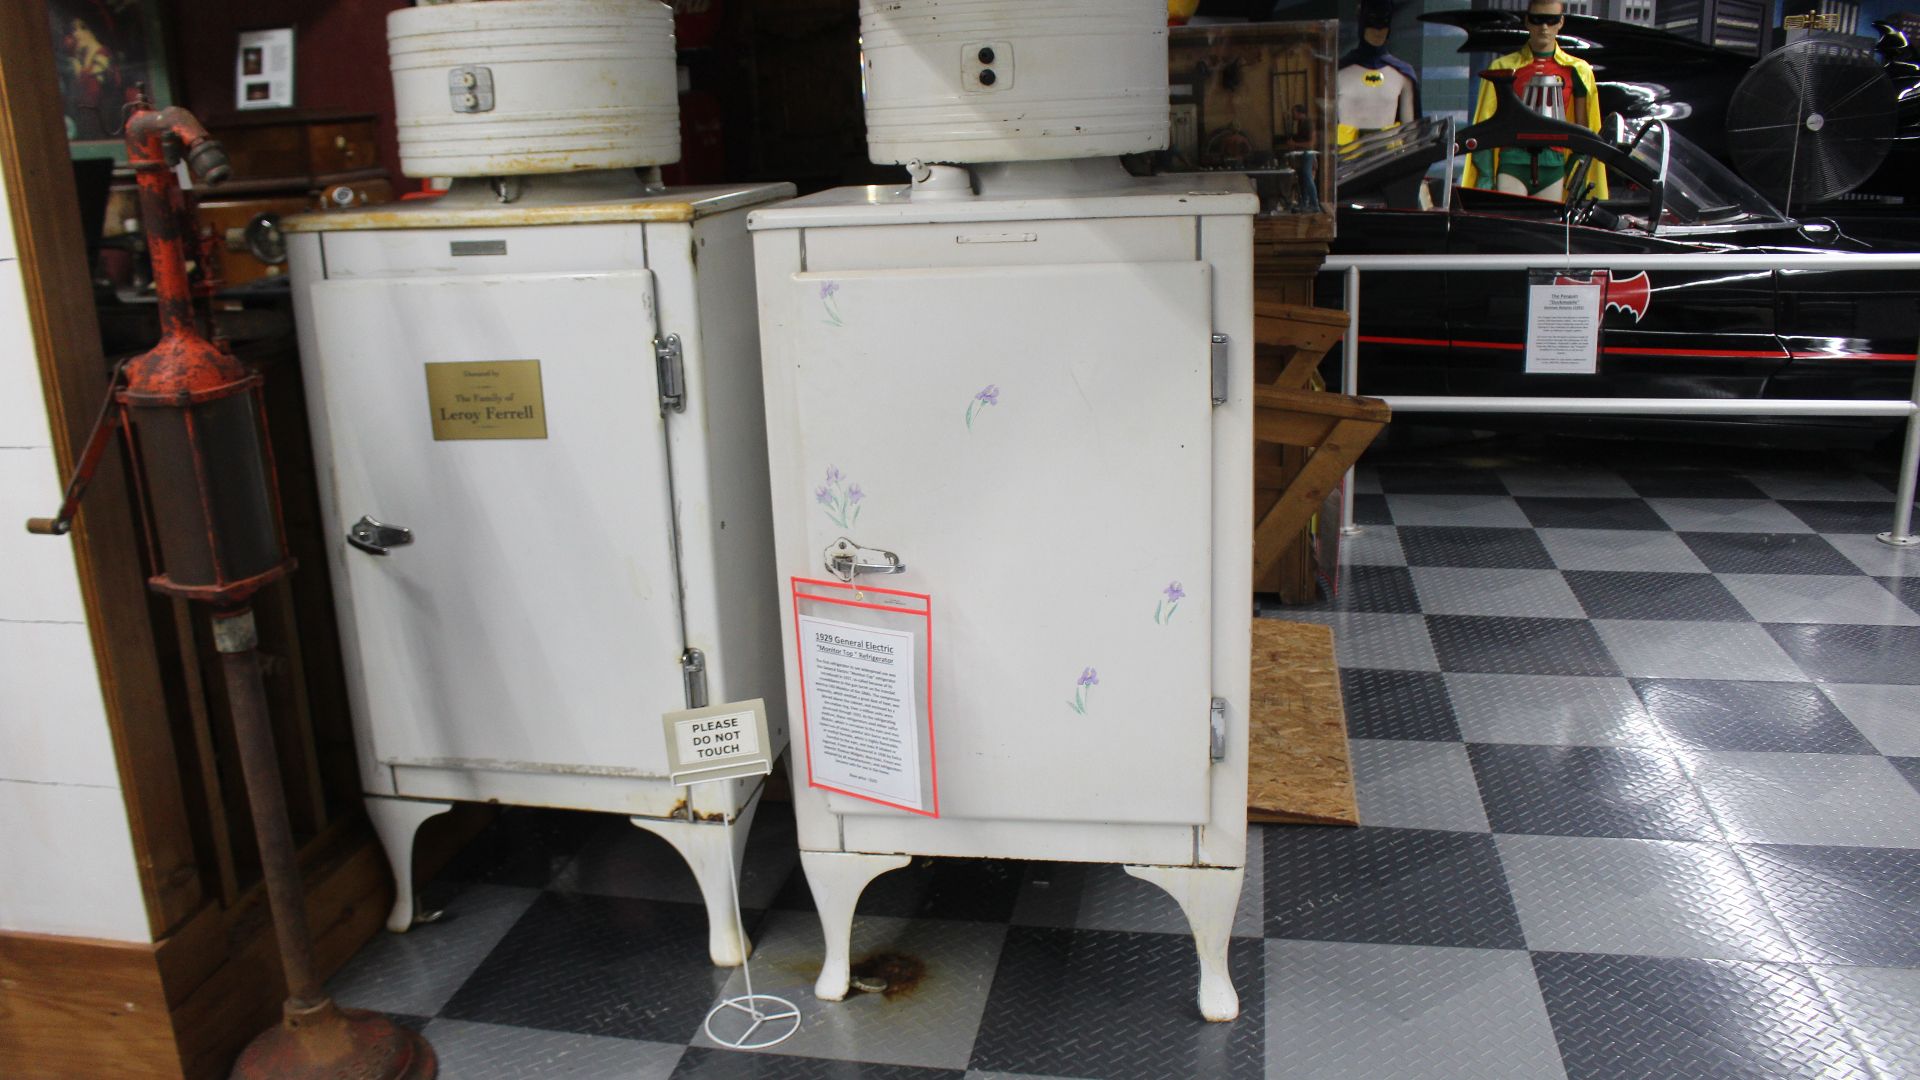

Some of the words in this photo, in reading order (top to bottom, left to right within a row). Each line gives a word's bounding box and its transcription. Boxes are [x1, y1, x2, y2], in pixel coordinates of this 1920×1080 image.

[456, 394, 470, 402] The
[473, 393, 501, 404] Family
[503, 392, 515, 401] of
[440, 407, 480, 424] Leroy
[486, 405, 533, 420] Ferrell
[815, 632, 833, 643] 1929
[834, 636, 863, 648] General
[865, 641, 894, 653] Electric
[859, 652, 894, 664] Refrigerator
[692, 718, 739, 733] PLEASE
[693, 735, 711, 746] DO
[715, 731, 741, 743] NOT
[697, 744, 740, 758] TOUCH
